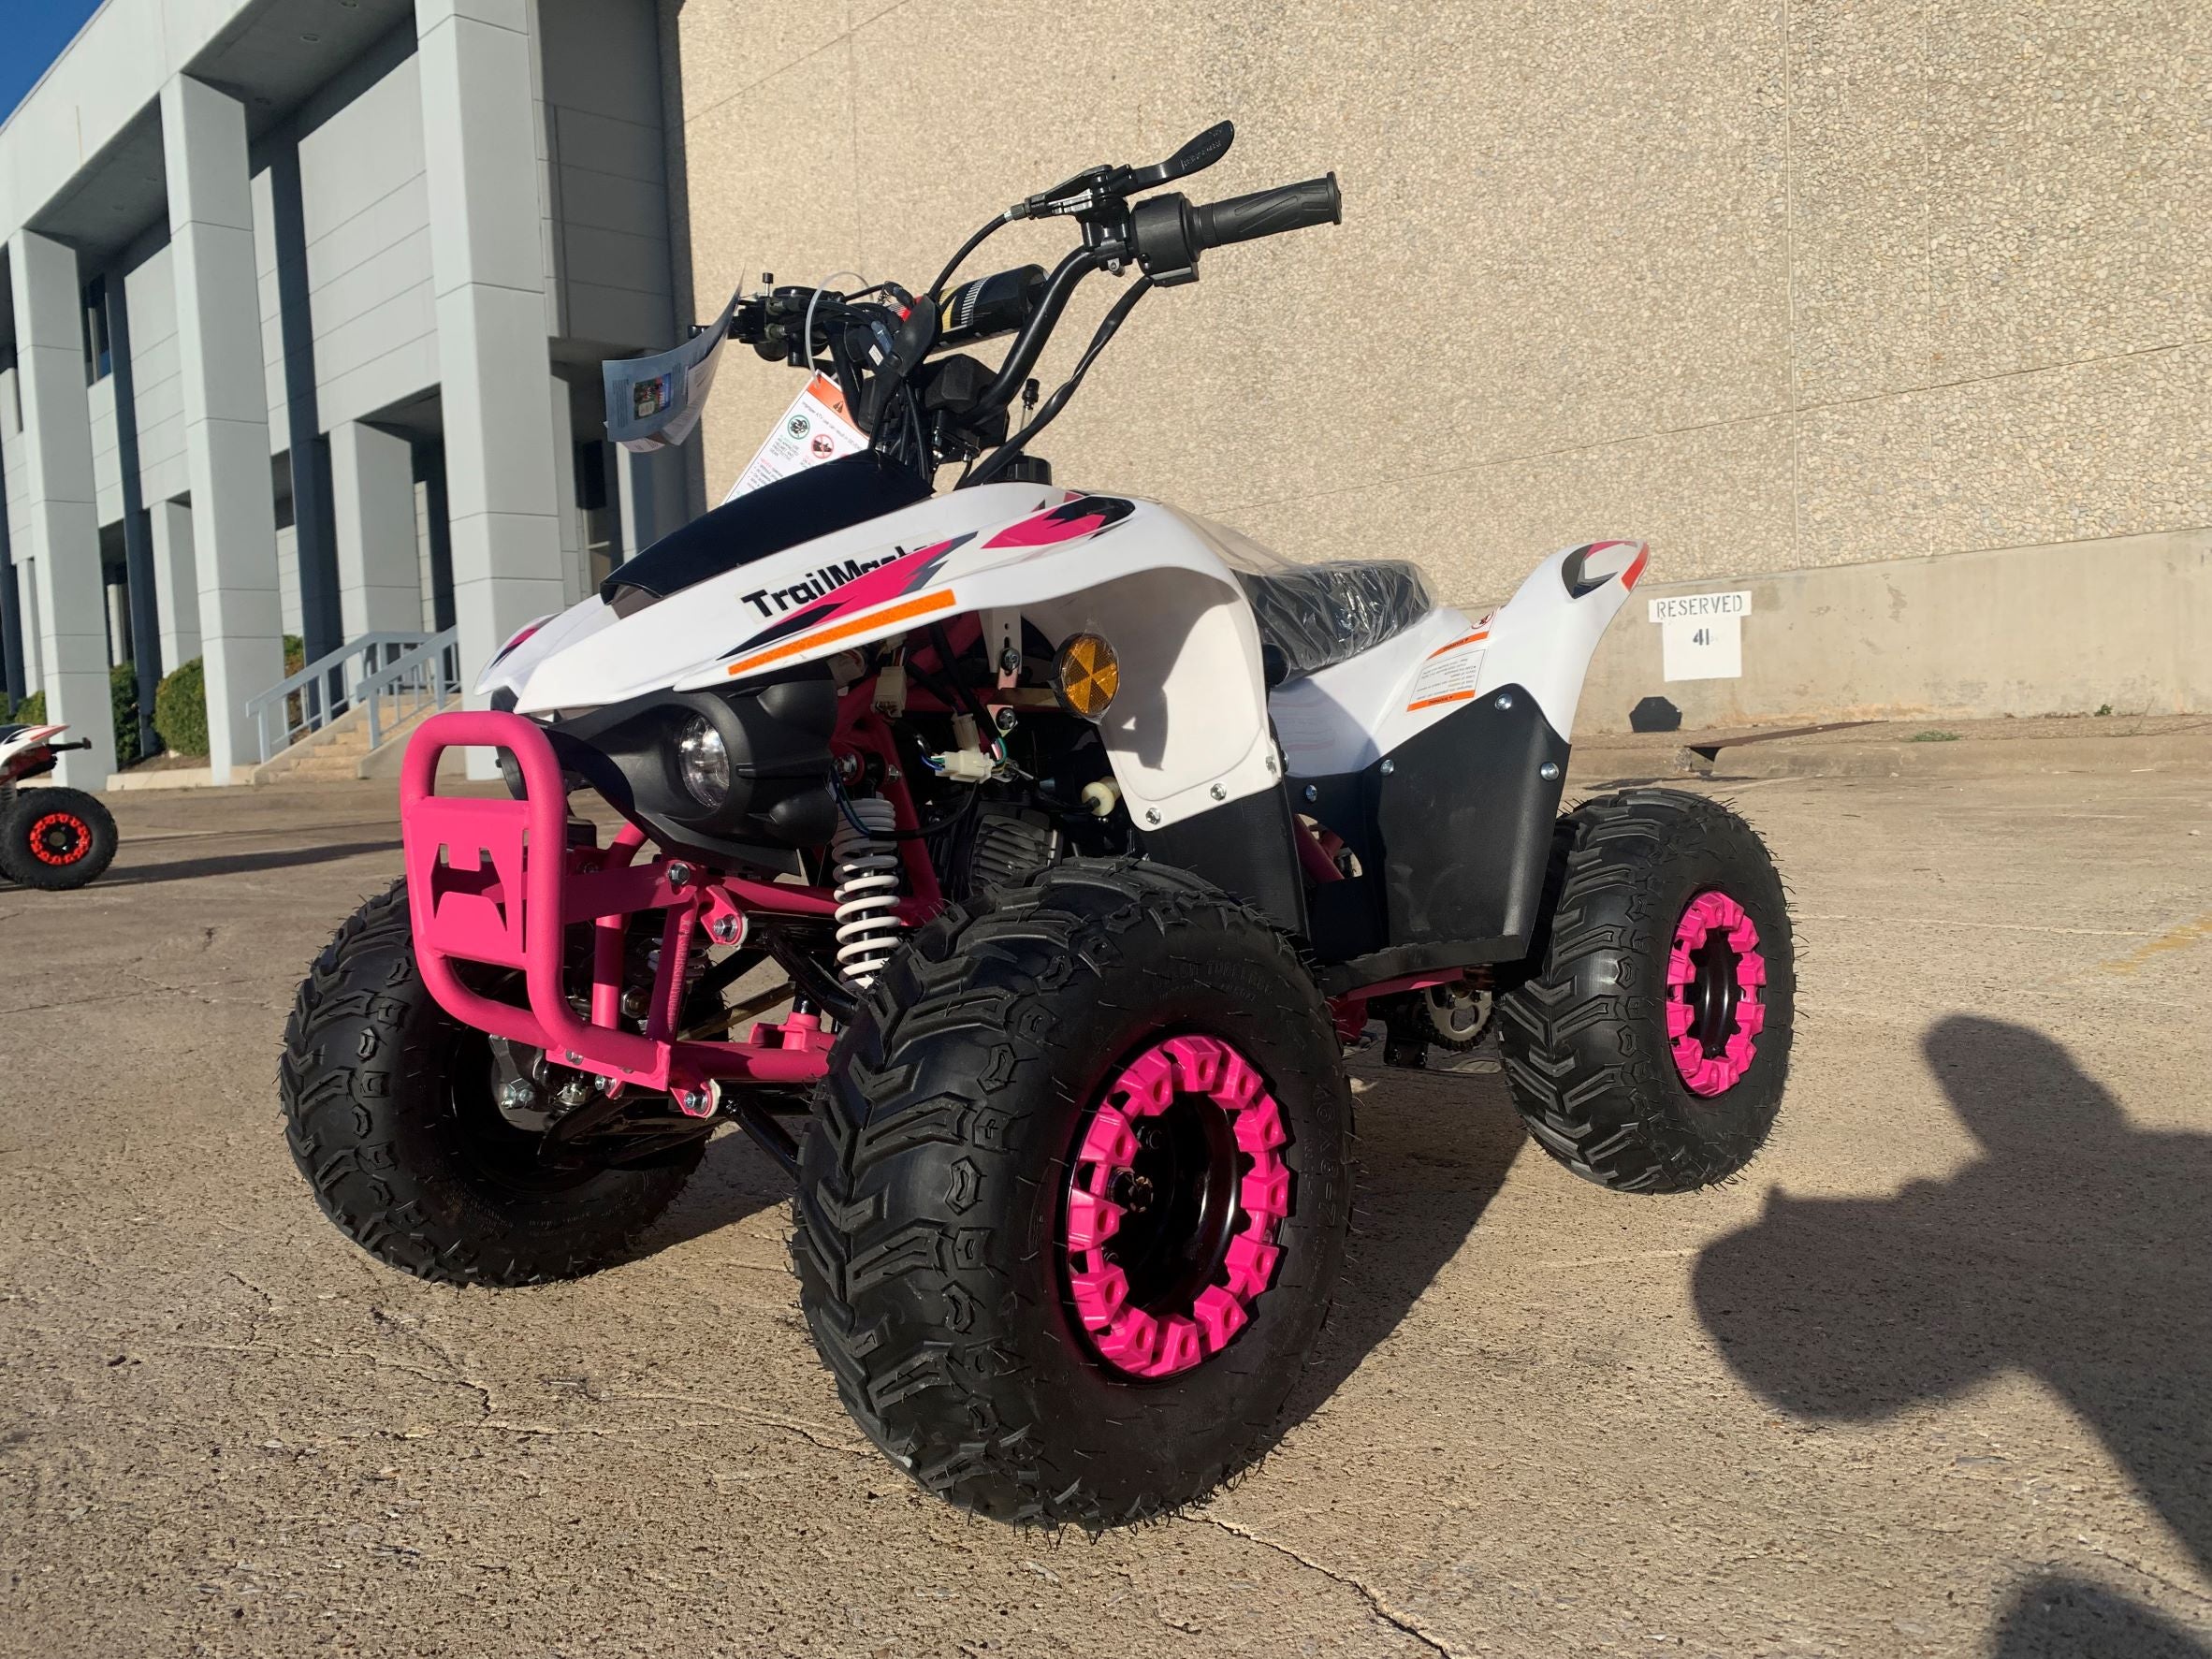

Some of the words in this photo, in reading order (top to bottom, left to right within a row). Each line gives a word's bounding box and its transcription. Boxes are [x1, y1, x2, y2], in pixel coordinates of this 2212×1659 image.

[740, 544, 934, 618] TrailMa
[1656, 594, 1743, 618] RESERVED
[1693, 628, 1710, 646] 41
